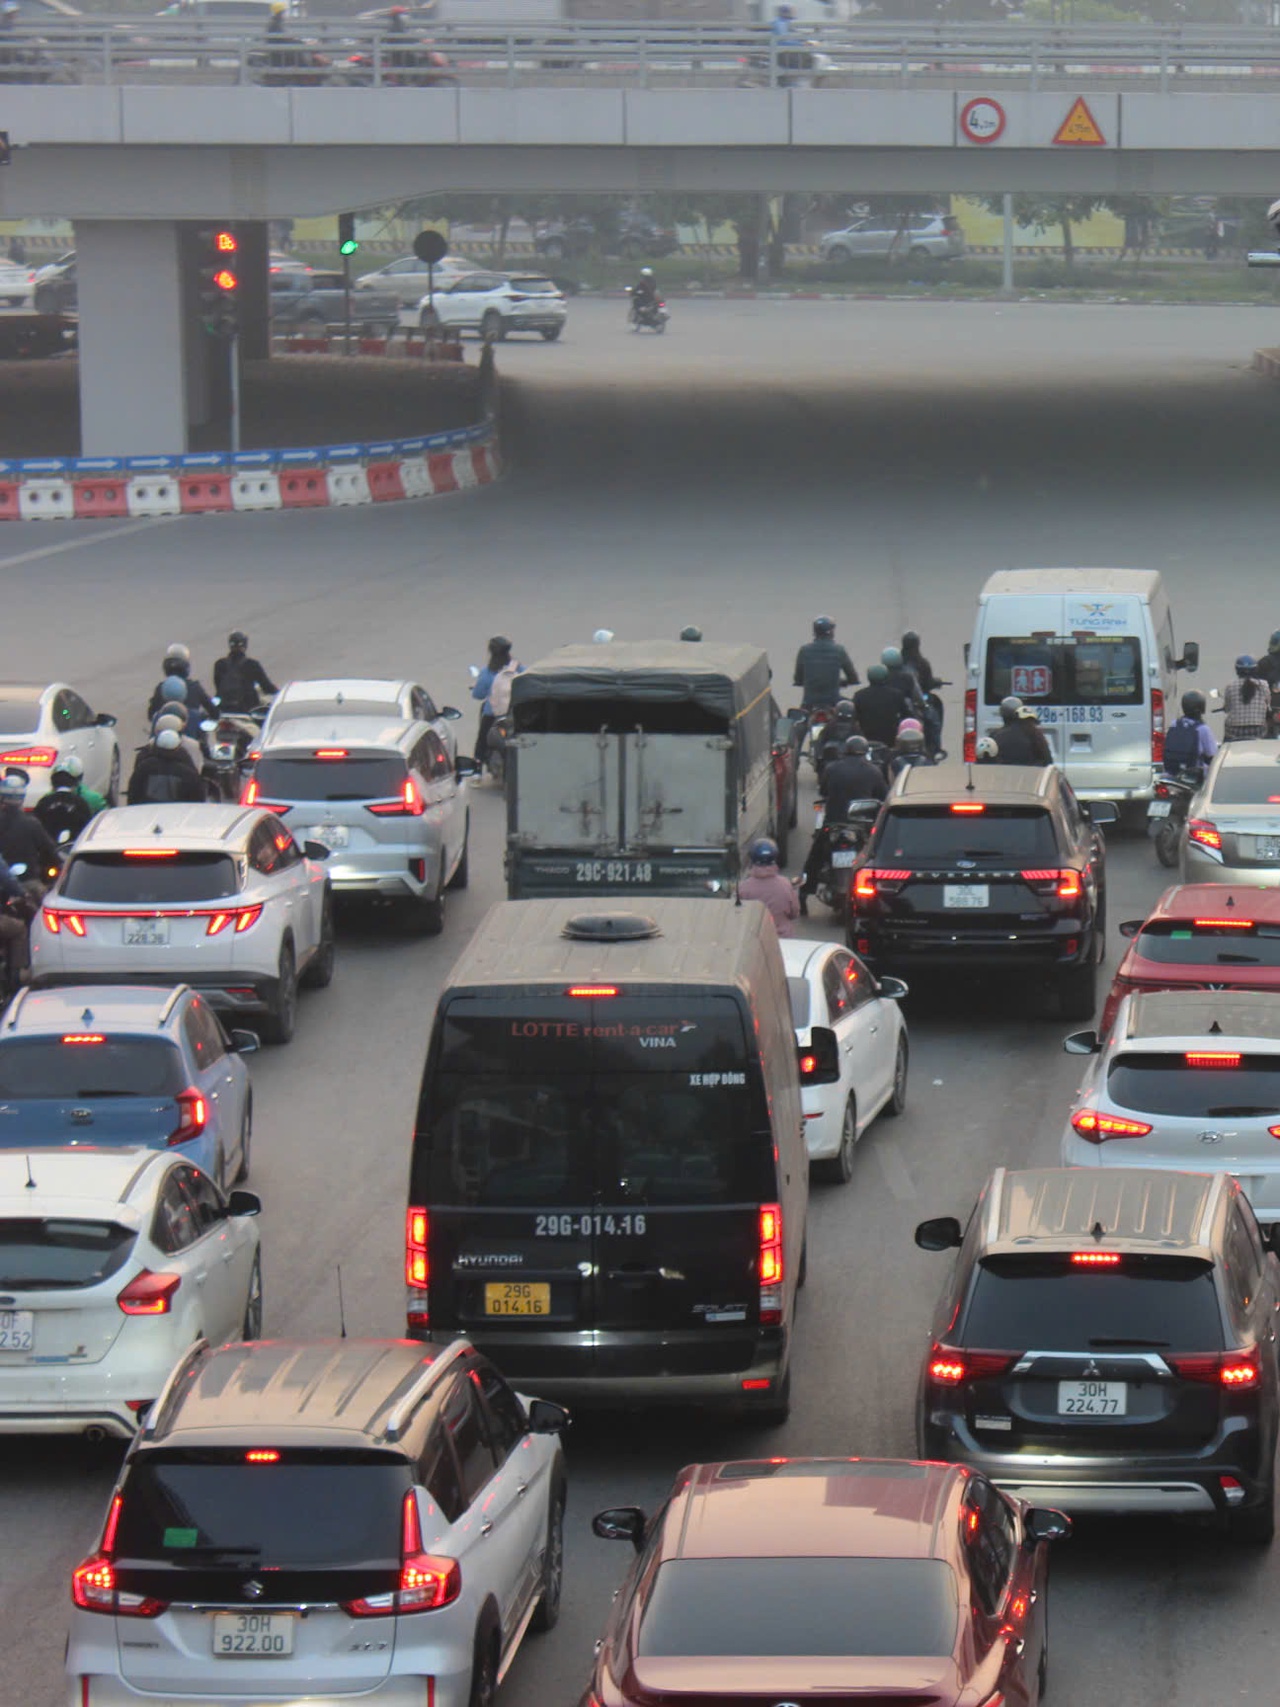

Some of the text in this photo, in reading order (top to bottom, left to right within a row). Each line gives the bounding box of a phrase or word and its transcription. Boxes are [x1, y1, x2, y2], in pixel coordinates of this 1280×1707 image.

[576, 863, 652, 882] 29C-921.48
[511, 1022, 679, 1037] LOTTE rent-a-car
[639, 1037, 677, 1048] VINA
[690, 1073, 701, 1086] XE
[536, 1215, 647, 1236] 29G-014.16
[458, 1254, 523, 1267] HYUNDAI
[504, 1284, 531, 1298] 29G
[492, 1299, 542, 1313] 014.16
[1078, 1383, 1107, 1397] 30H
[1066, 1399, 1119, 1413] 224.77
[237, 1615, 271, 1634] 30H
[221, 1635, 285, 1653] 922.00
